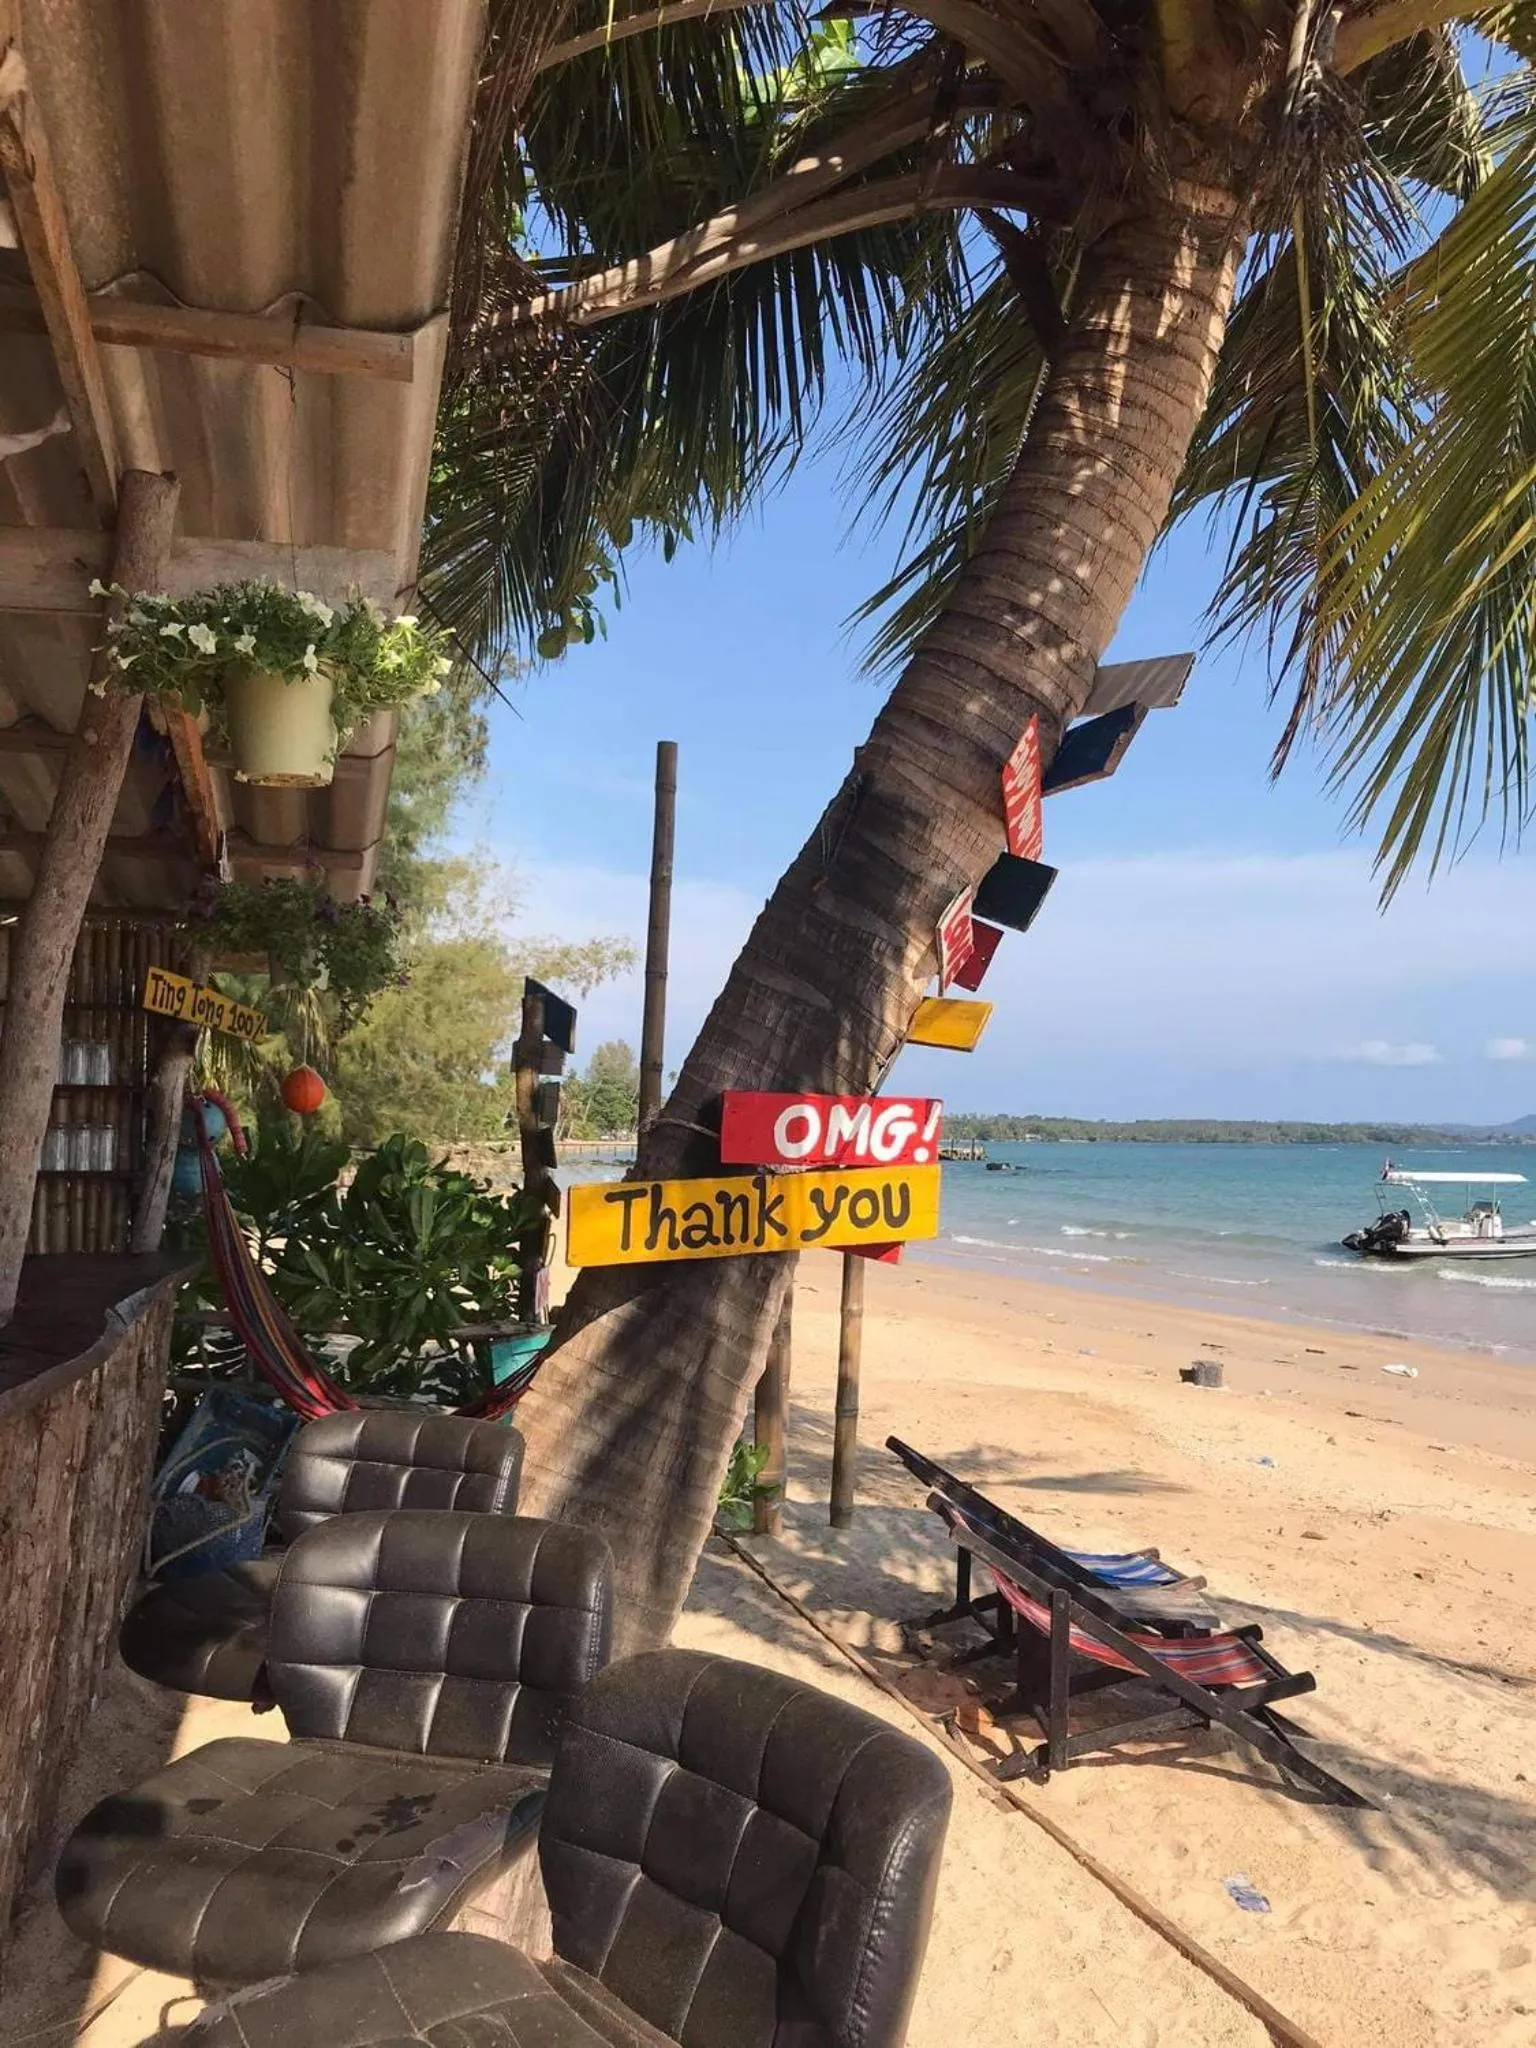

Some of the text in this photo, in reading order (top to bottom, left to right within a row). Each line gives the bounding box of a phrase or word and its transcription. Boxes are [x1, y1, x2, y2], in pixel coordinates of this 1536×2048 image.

[151, 973, 266, 1040] Ting Tong 100%
[774, 1103, 942, 1162] OMG!
[604, 1176, 910, 1251] Thank you
